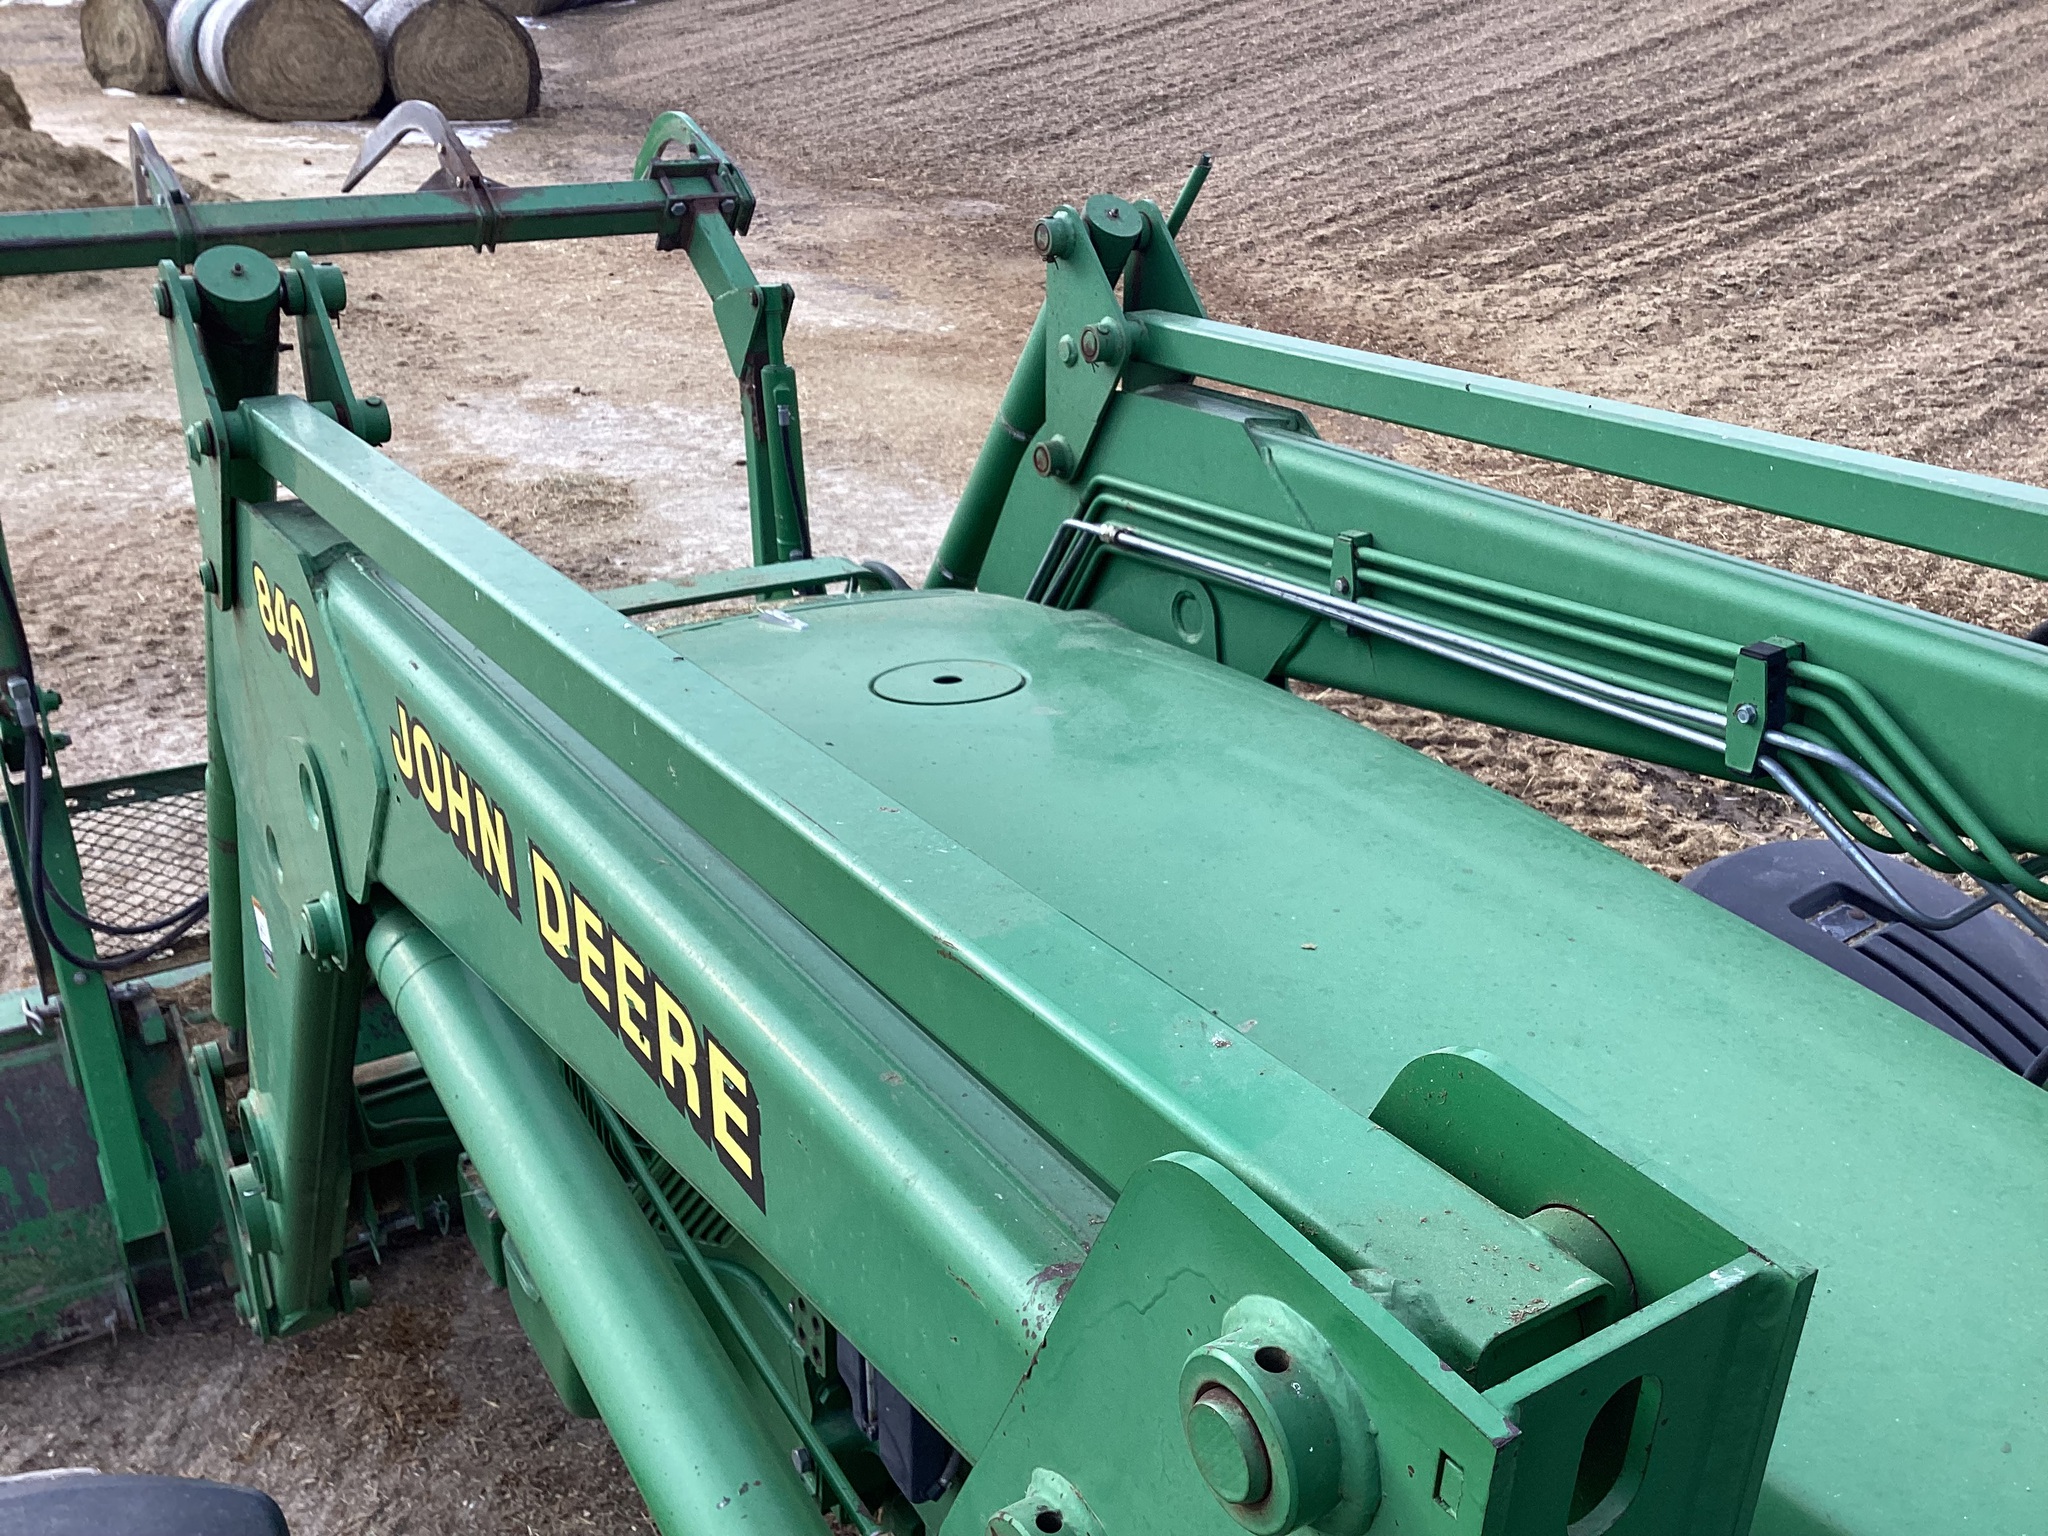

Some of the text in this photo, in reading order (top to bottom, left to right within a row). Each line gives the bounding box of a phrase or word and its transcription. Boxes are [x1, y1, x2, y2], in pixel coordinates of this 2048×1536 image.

[253, 564, 315, 680] 840
[392, 702, 753, 1181] JOHN DEERE
